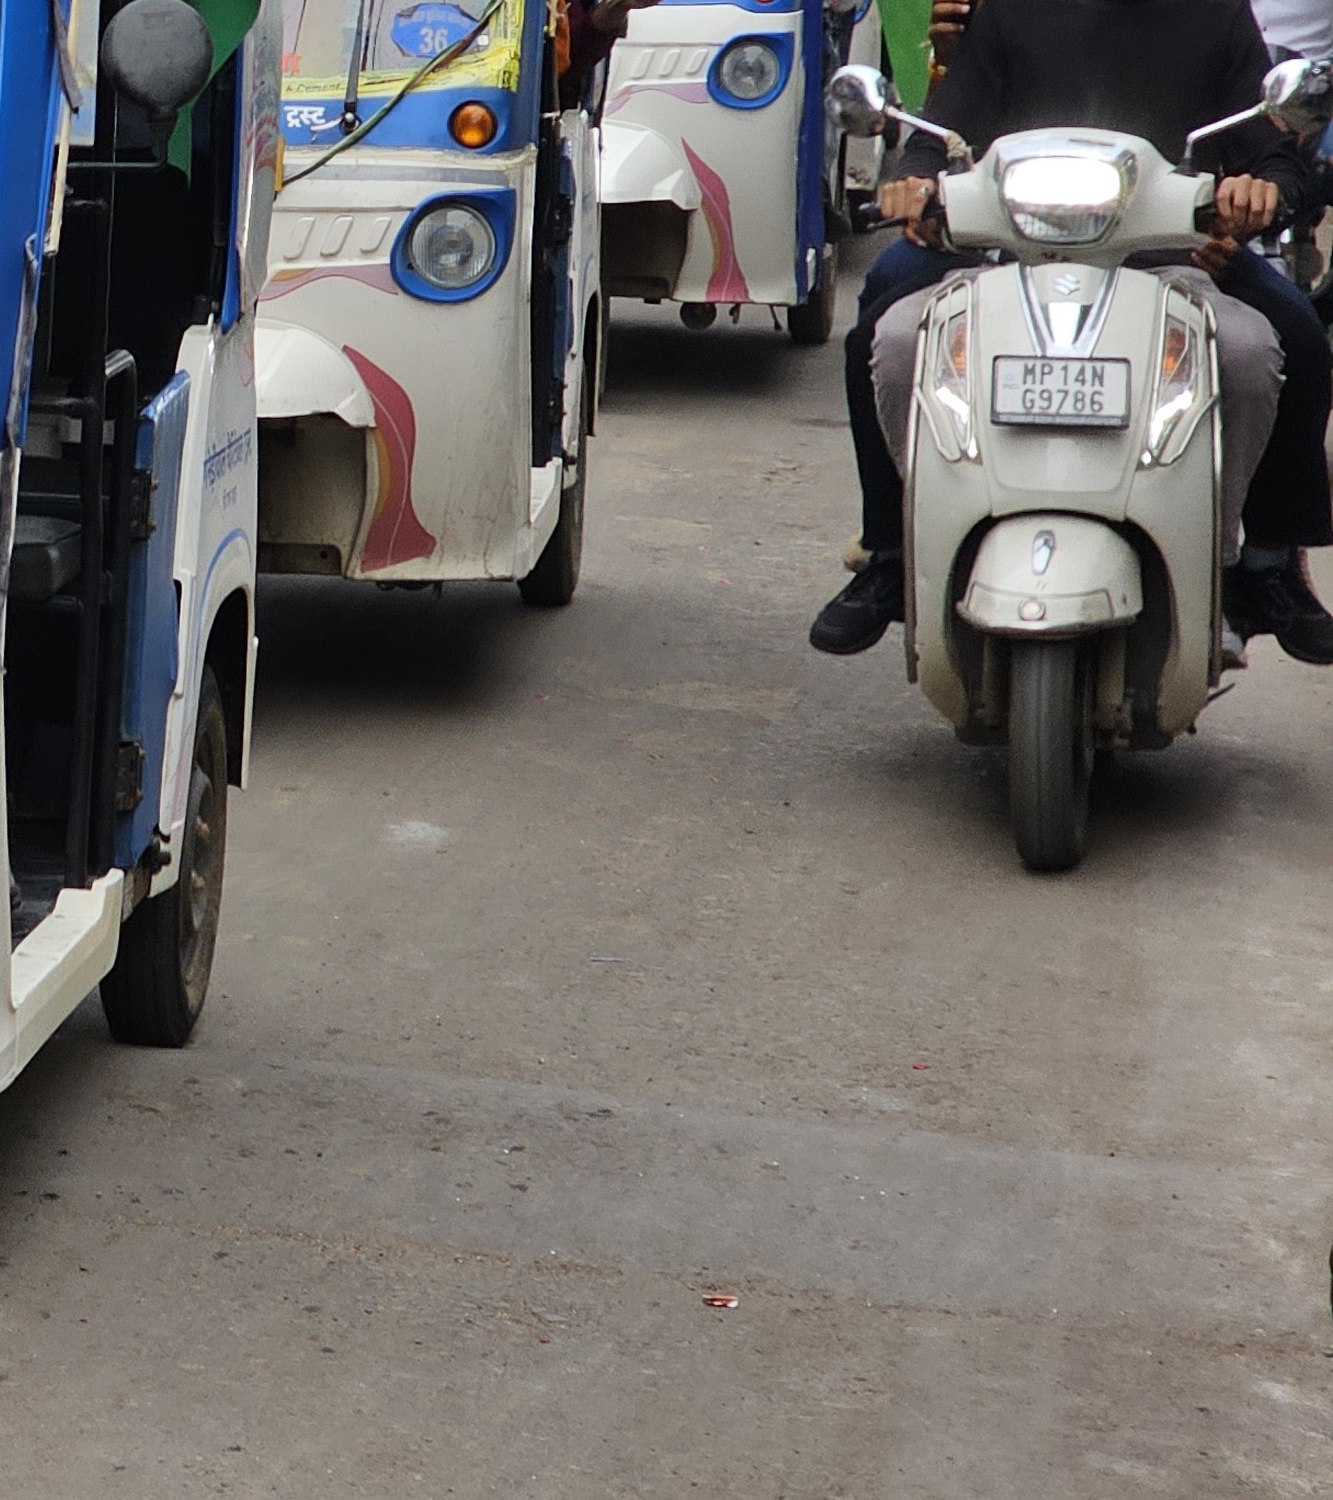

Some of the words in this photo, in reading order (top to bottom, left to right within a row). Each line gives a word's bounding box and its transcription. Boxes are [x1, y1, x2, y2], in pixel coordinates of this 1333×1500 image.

[419, 26, 449, 52] 36
[284, 105, 325, 128] ट्रस्ट
[1022, 362, 1105, 387] MP14N
[1022, 388, 1105, 415] G9786
